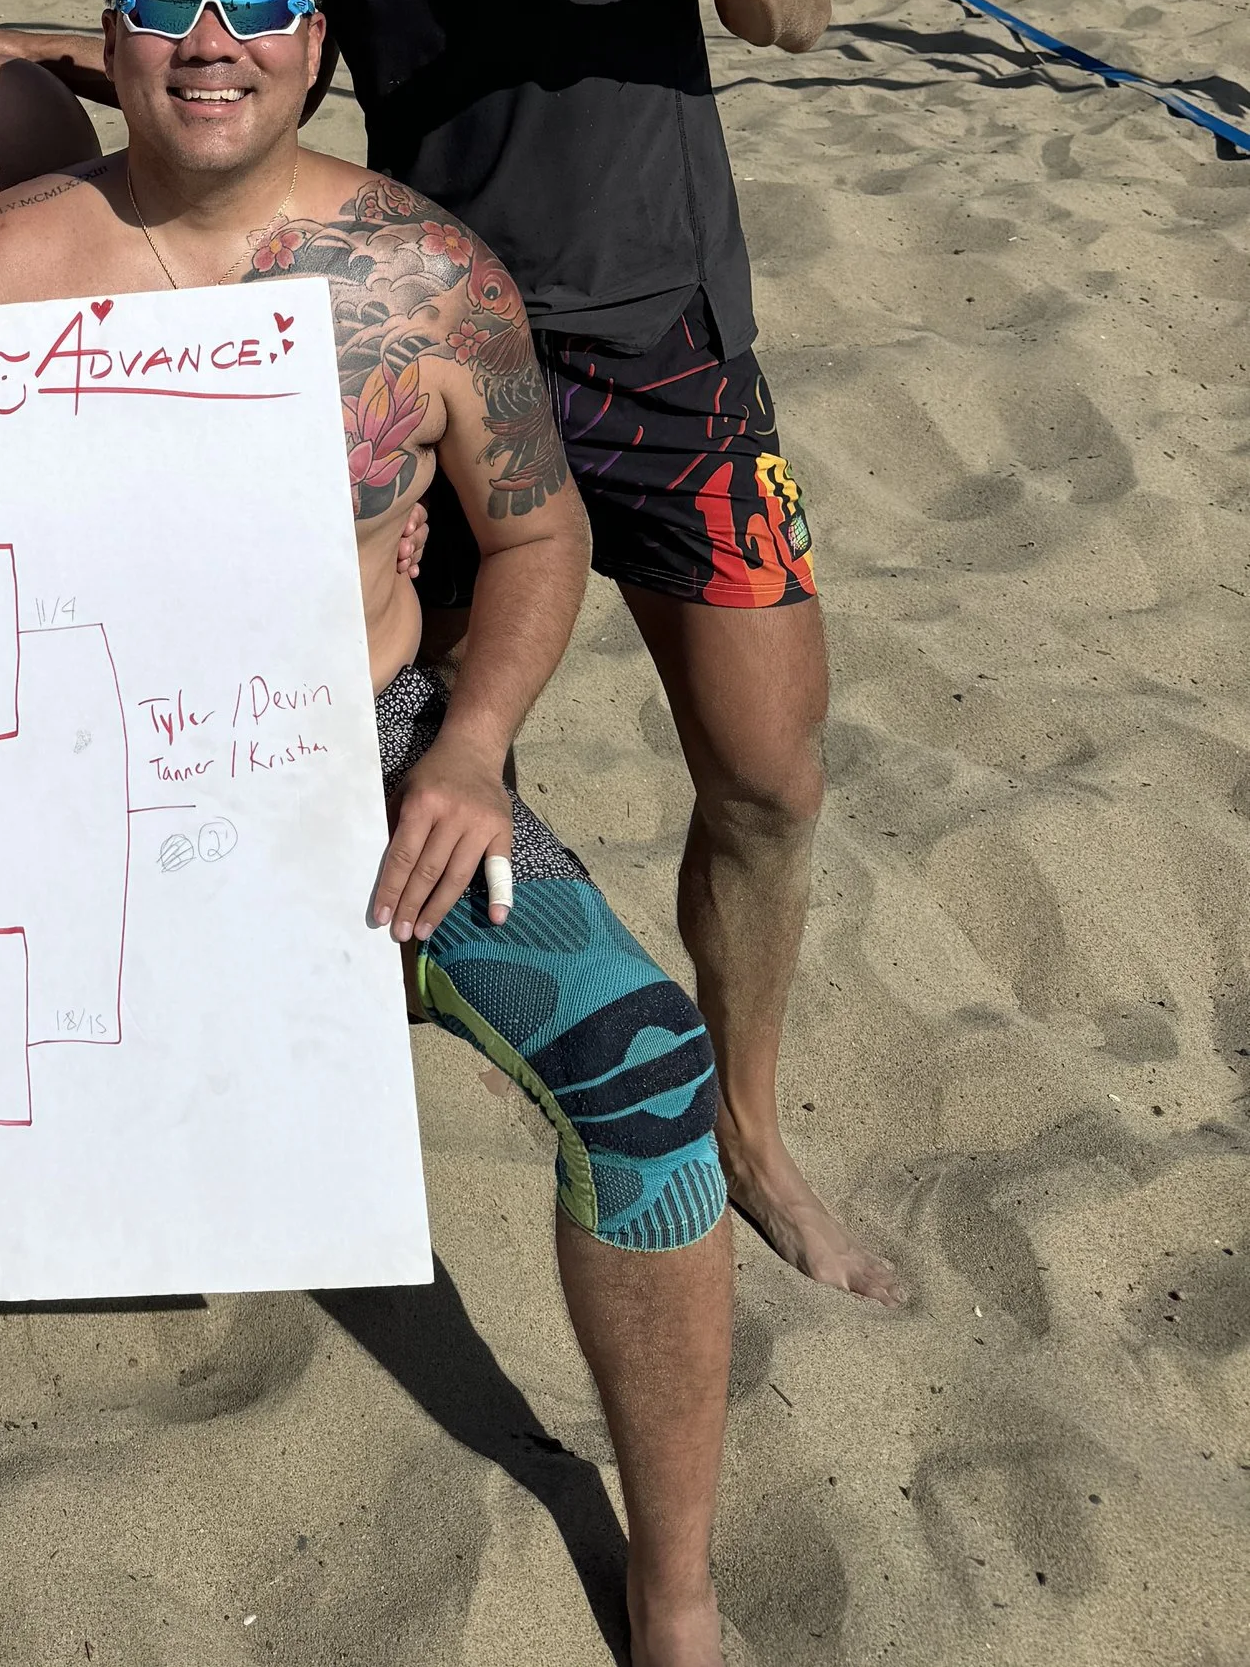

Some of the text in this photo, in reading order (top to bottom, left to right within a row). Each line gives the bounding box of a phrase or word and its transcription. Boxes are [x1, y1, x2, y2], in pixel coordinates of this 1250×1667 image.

[35, 596, 76, 626] 11/4
[138, 689, 215, 746] Tyler
[149, 757, 215, 781] Tanner
